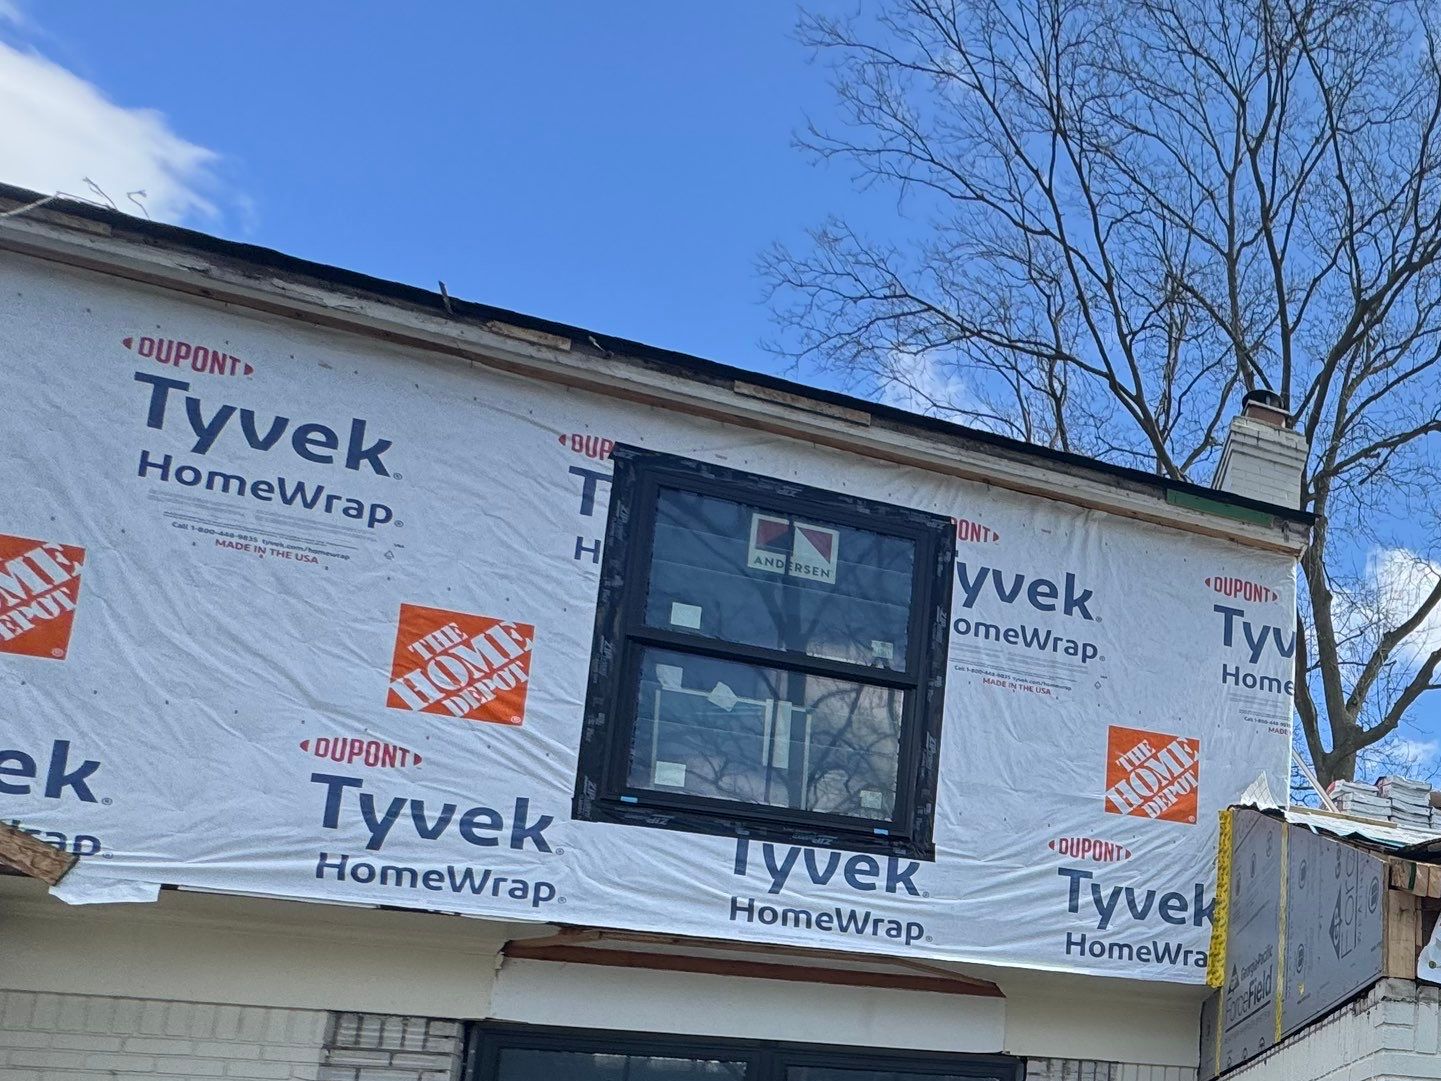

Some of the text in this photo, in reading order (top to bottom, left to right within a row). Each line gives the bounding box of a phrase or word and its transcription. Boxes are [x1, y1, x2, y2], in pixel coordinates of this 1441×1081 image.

[138, 336, 241, 376] DUPONT
[134, 371, 393, 478] Tyvek
[571, 433, 616, 461] DUP
[137, 450, 394, 529] HomeWrap
[215, 539, 319, 564] MADE IN THE USA
[950, 517, 991, 543] ONT
[753, 555, 832, 579] ANDERSEN
[956, 561, 1094, 621] yvek
[1214, 576, 1271, 603] DUPONT
[407, 622, 469, 662] THE
[953, 617, 1098, 664] omeWrap
[1213, 604, 1296, 664] Tyv
[389, 621, 534, 711] HOME
[982, 678, 1006, 688] MADE
[1019, 684, 1034, 693] THE
[1035, 686, 1051, 695] USA
[1222, 663, 1295, 696] Home
[442, 661, 529, 718] DEPOT
[314, 737, 410, 768] DUPONT
[1115, 739, 1156, 773] THE
[1105, 737, 1199, 815] HOME
[1142, 770, 1198, 819] DEPOT
[310, 772, 554, 854] Tyvek
[1058, 837, 1123, 862] DUPONT
[316, 852, 556, 907] HomeWrap
[1057, 867, 1217, 930] Tyvek
[729, 896, 924, 945] HomeWrap
[1065, 932, 1209, 968] HomeWra
